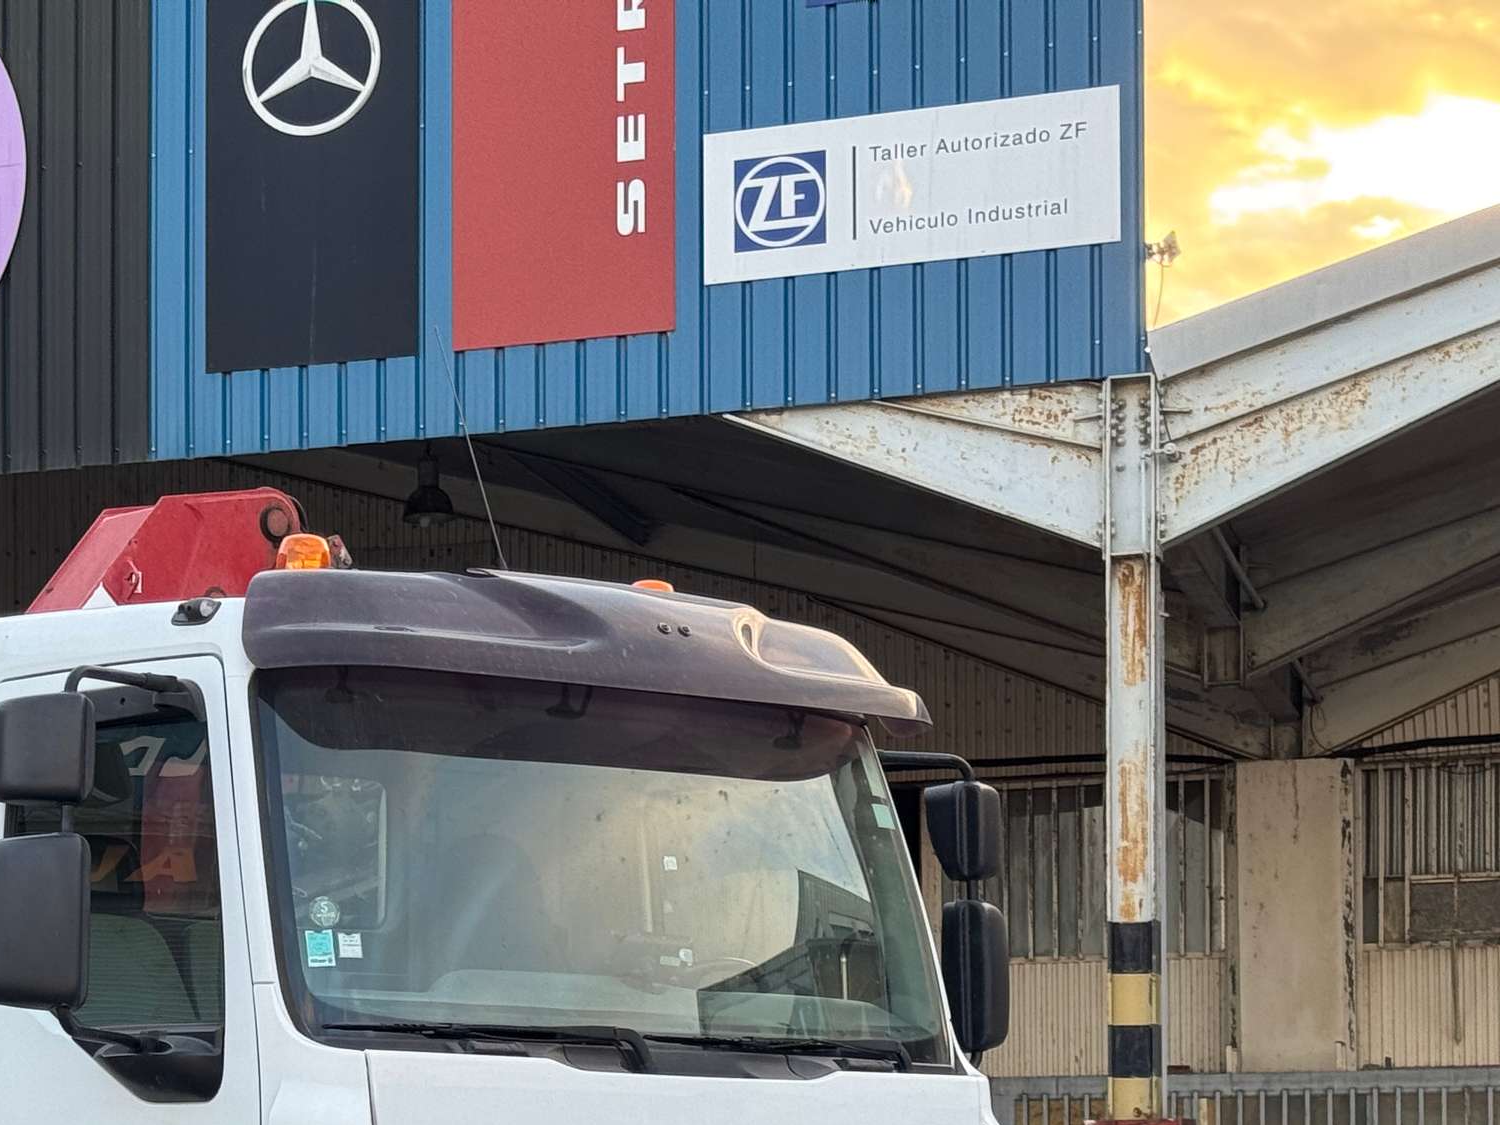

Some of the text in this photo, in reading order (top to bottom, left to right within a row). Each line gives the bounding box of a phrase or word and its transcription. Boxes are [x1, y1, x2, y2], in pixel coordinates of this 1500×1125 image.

[869, 121, 1088, 162] Taller Autorizado ZF
[743, 171, 819, 234] ZF
[968, 198, 1068, 225] Industrial
